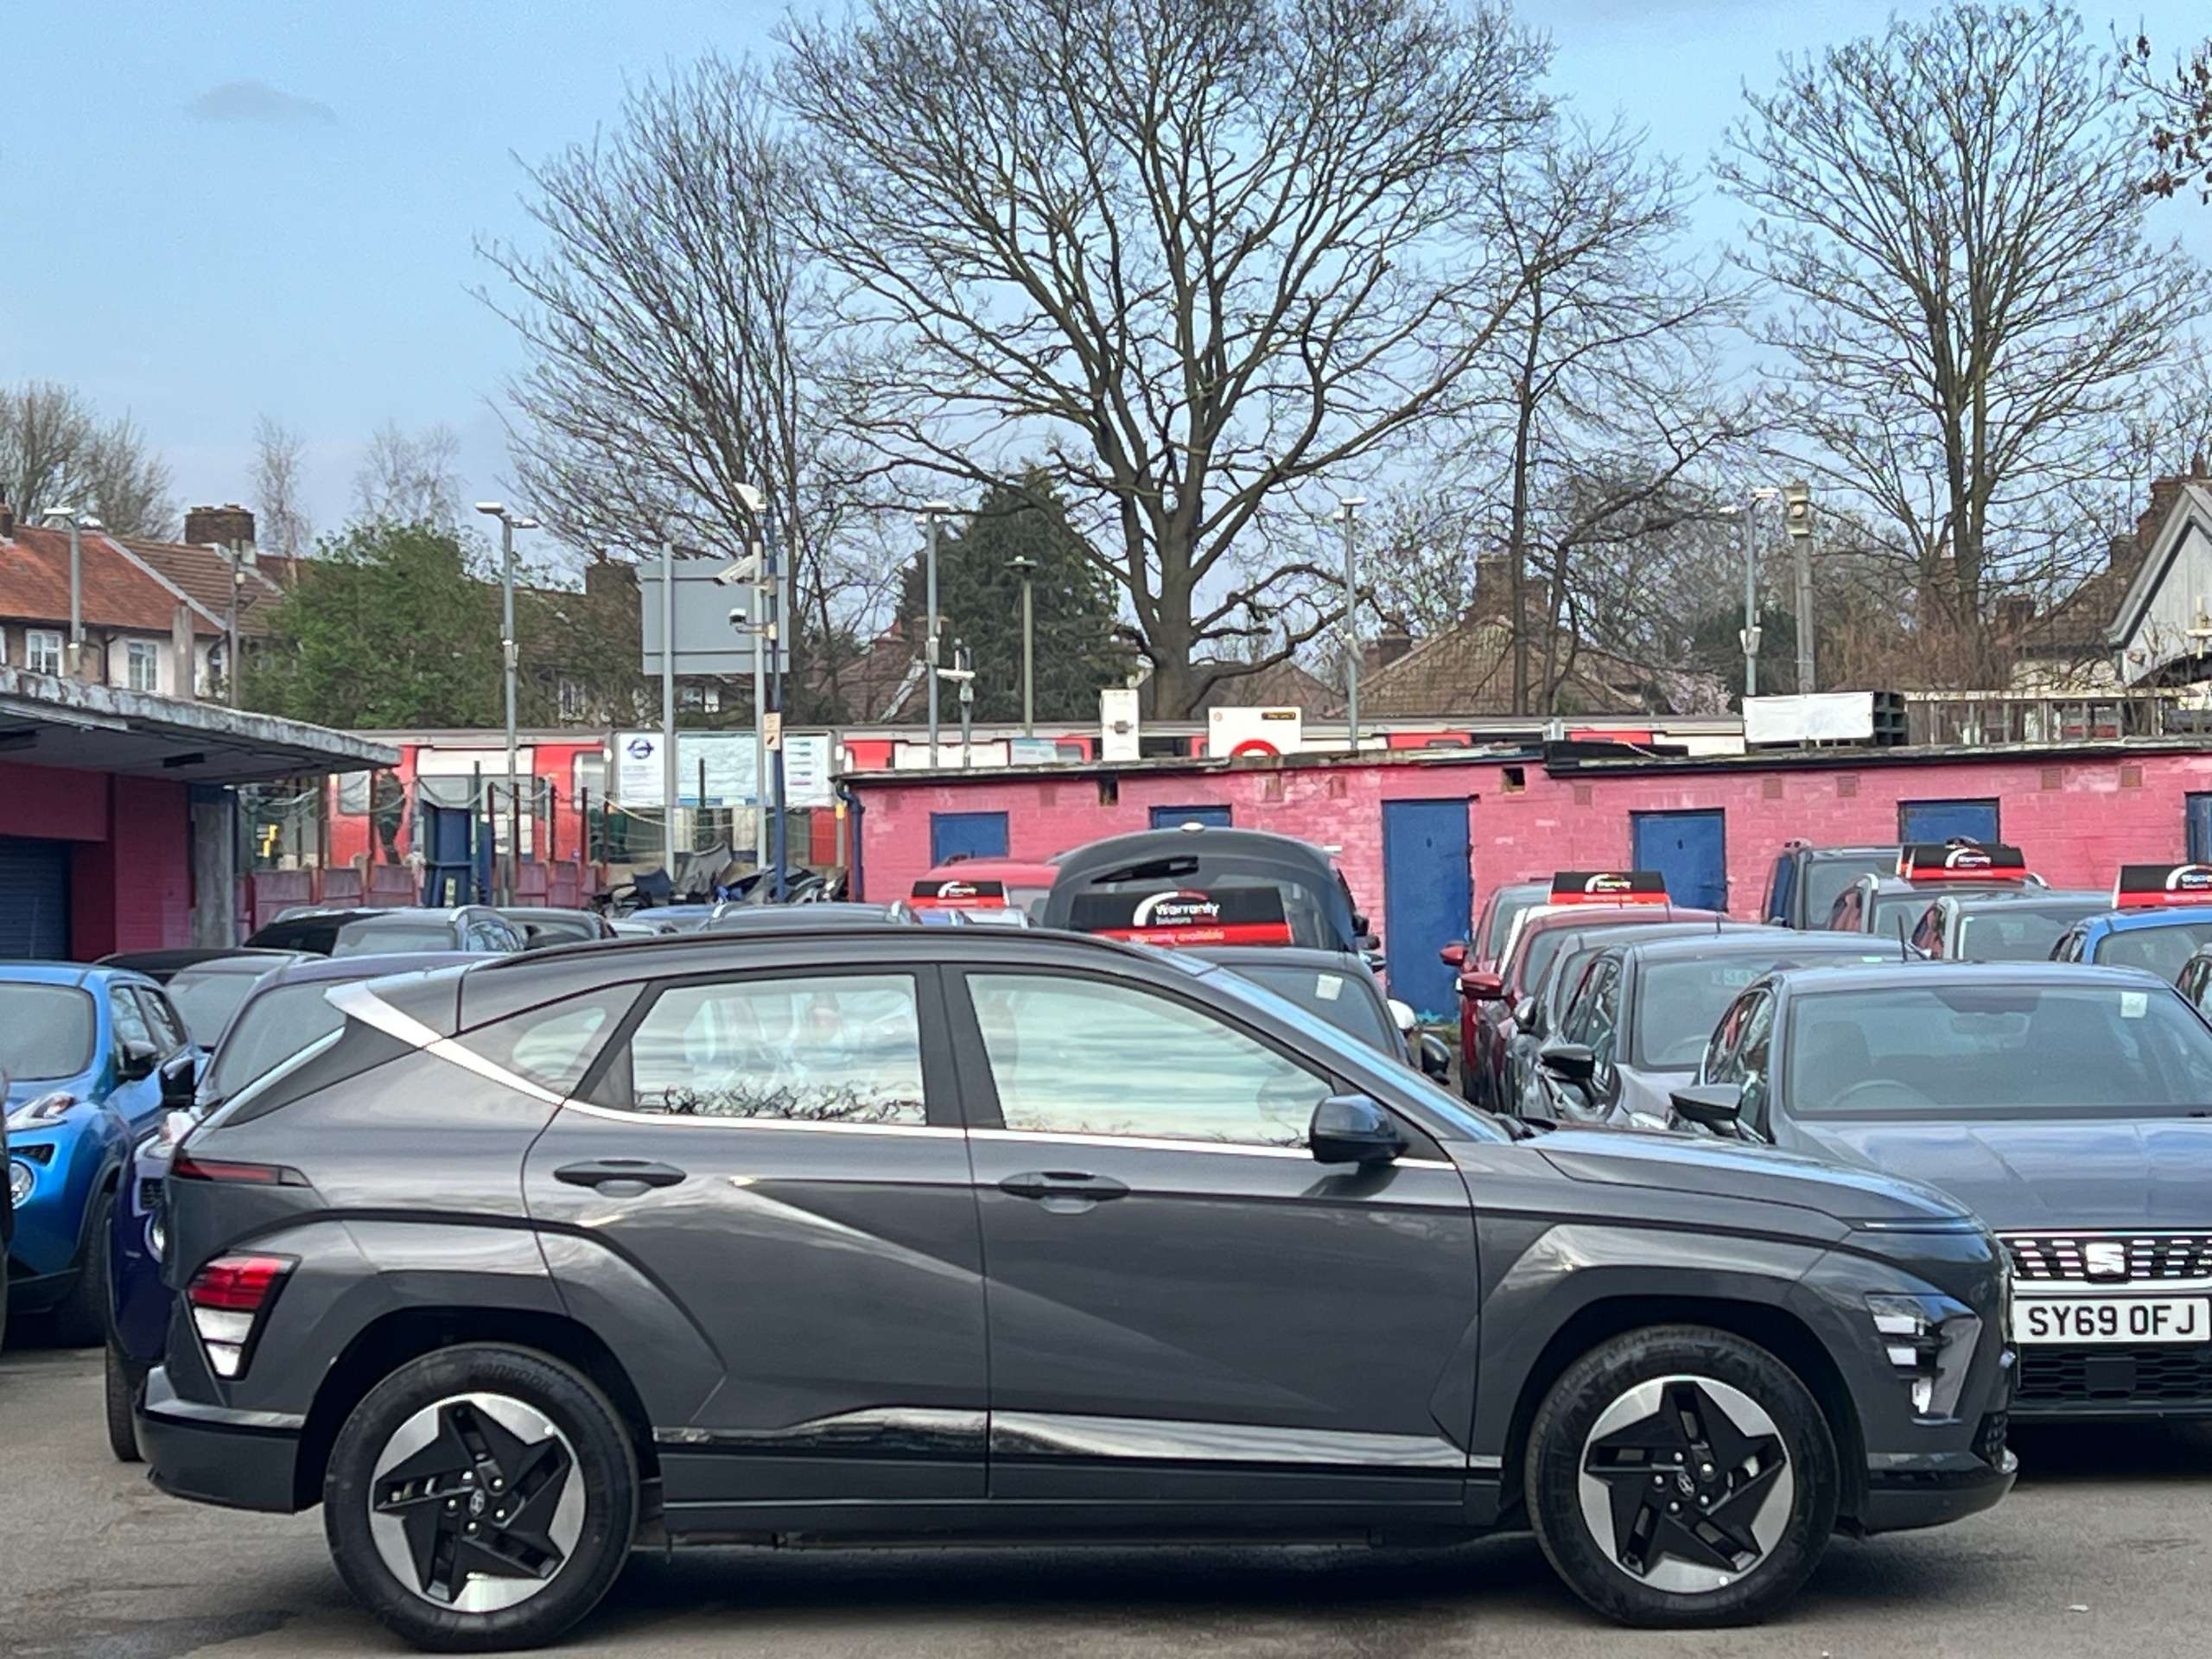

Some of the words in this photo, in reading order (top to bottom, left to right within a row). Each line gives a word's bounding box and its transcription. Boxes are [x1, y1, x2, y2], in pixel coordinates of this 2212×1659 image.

[1154, 902, 1220, 917] Warranty
[2027, 1305, 2118, 1337] SY69
[2129, 1304, 2195, 1336] OFJ
